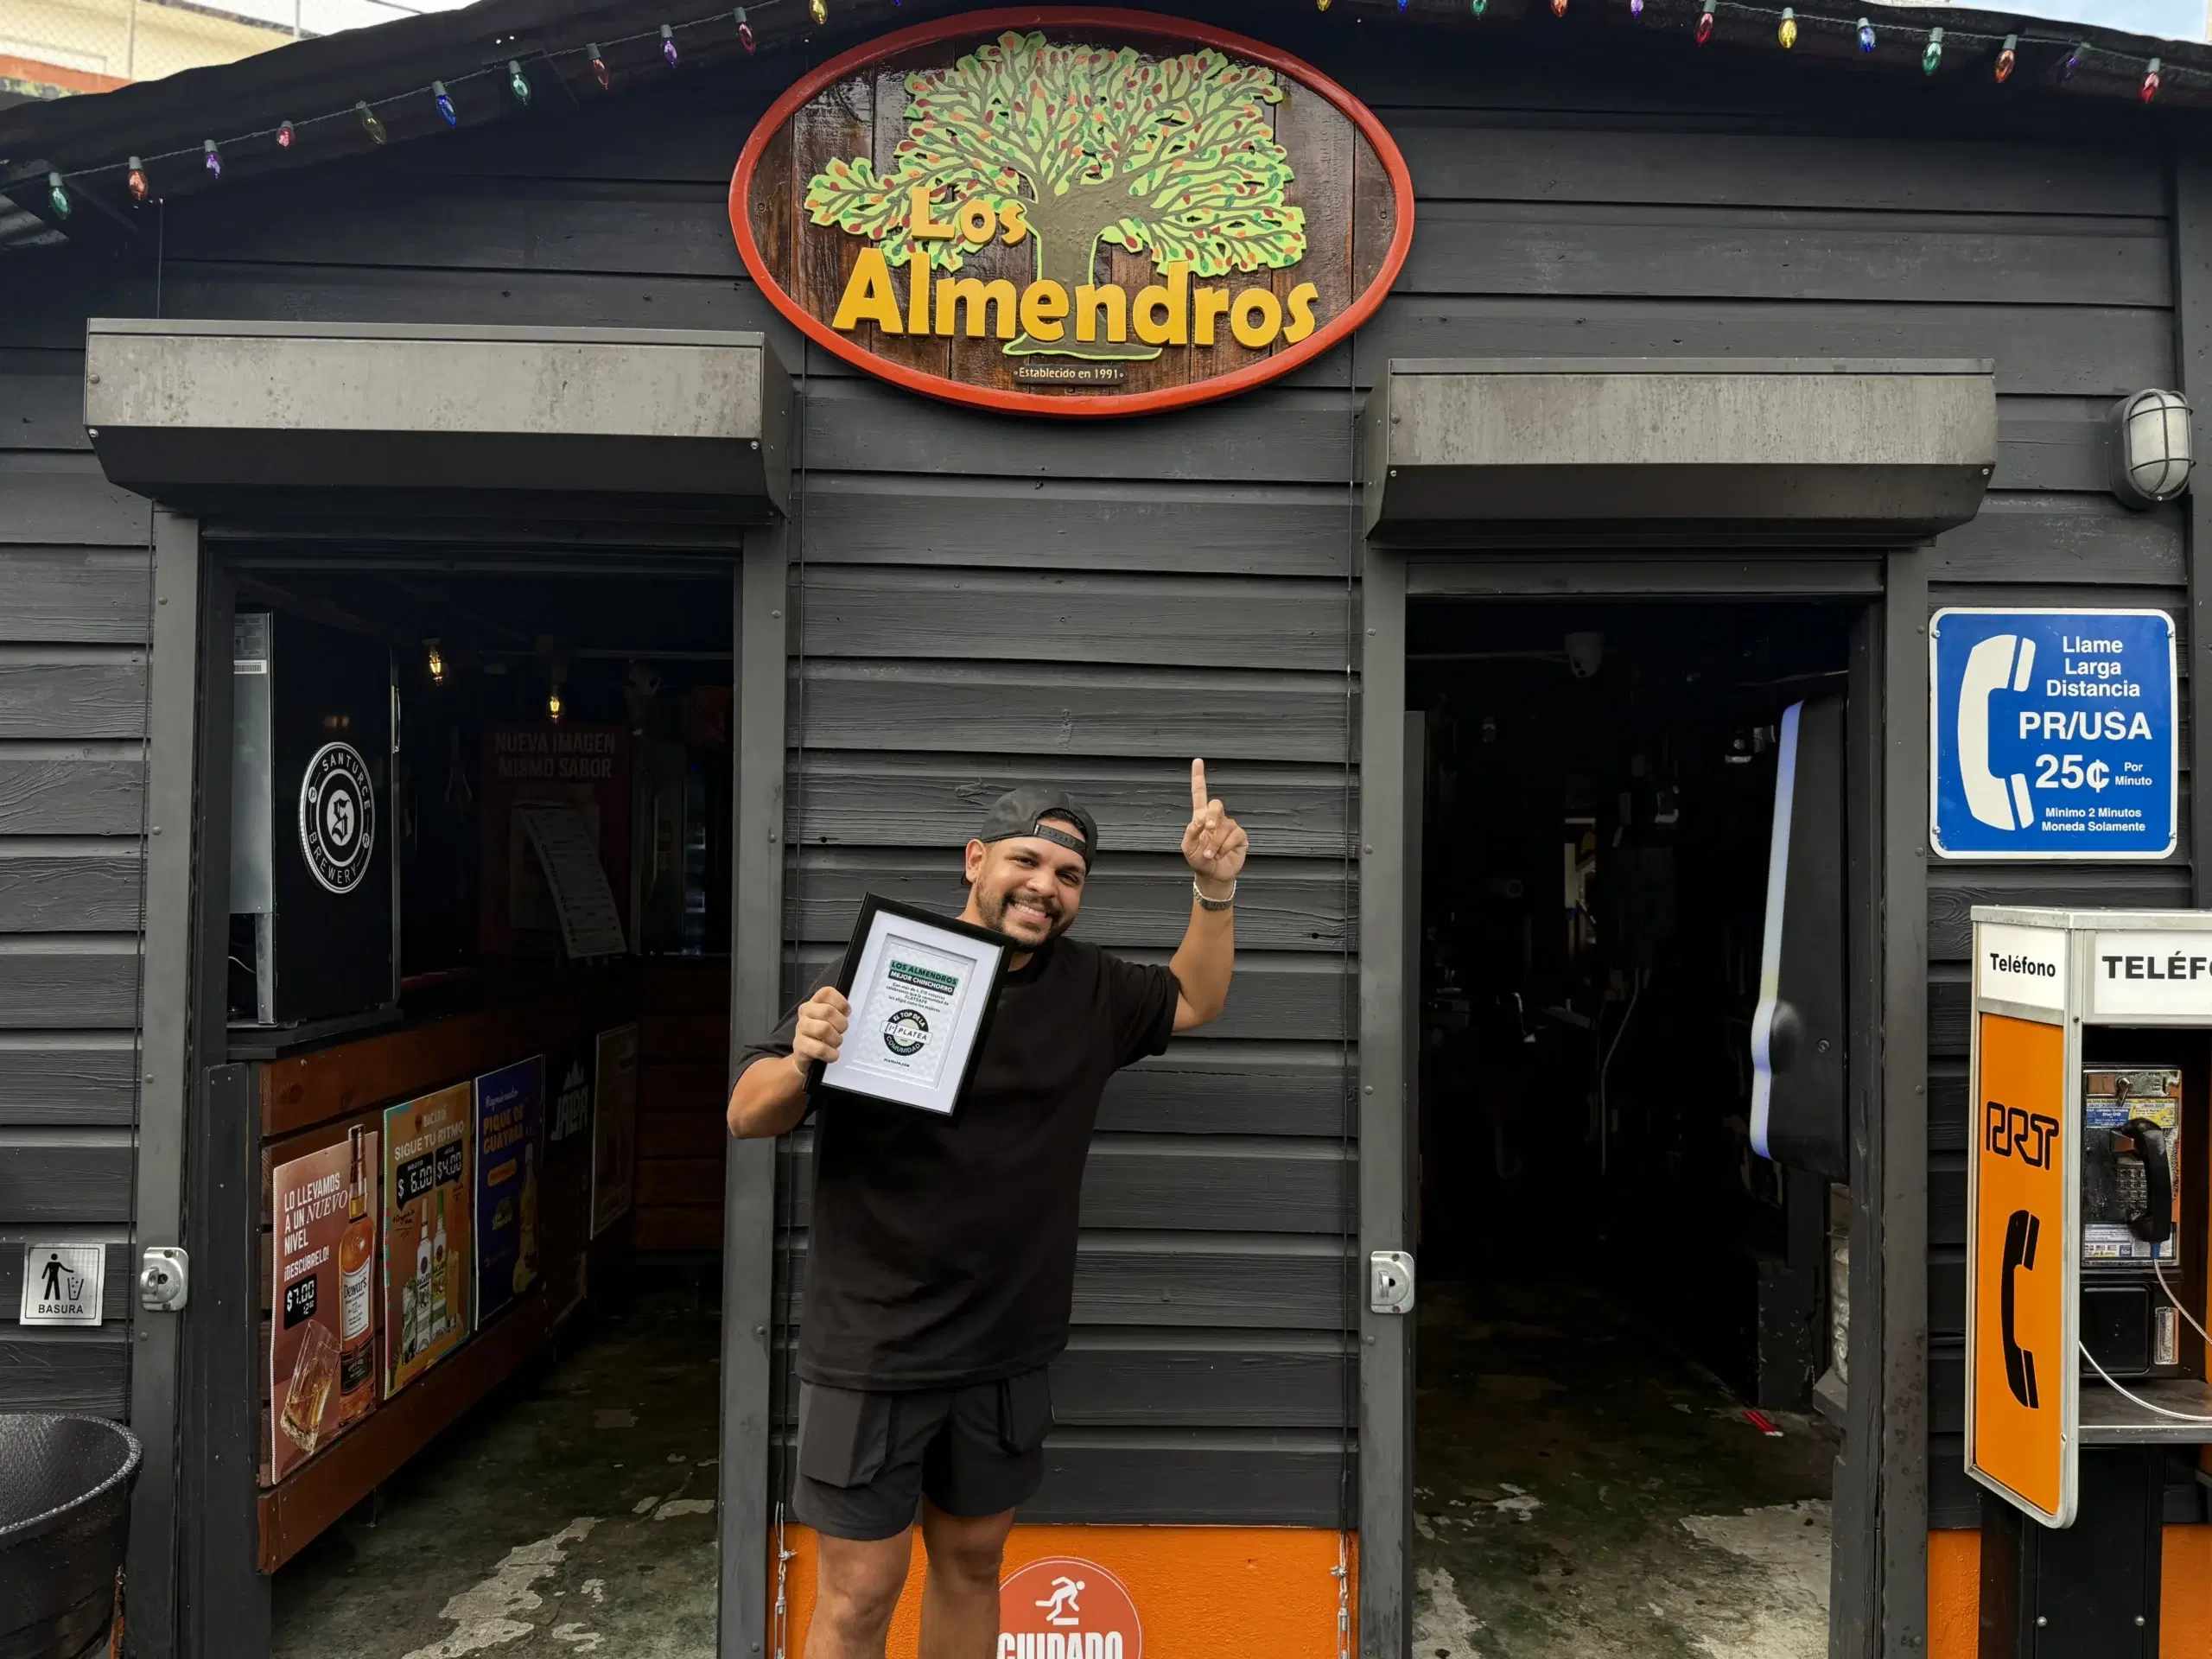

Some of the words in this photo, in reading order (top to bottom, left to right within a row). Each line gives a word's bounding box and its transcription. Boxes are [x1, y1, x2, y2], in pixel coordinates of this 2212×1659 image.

[912, 186, 1027, 245] Los
[831, 247, 1319, 348] Almendros
[1019, 367, 1076, 378] Establecido
[1095, 369, 1117, 379] 1991
[2063, 636, 2123, 653] Llame
[2065, 658, 2121, 679] Larga
[2046, 679, 2140, 697] Distancia
[2019, 711, 2152, 741] PR/USA
[2035, 753, 2110, 793] 25¢
[2124, 762, 2144, 772] Por
[322, 753, 371, 810] SANTURCE
[2115, 776, 2152, 786] Minuto
[2088, 808, 2095, 817] 2
[2098, 807, 2142, 817] Minutos
[2042, 822, 2085, 832] Moneda
[2088, 822, 2145, 832] Solamente
[309, 832, 357, 885] BREWERY
[892, 961, 908, 971] LOS
[908, 967, 957, 985] ALMENDROS
[1990, 952, 2056, 977] Teléfono
[2102, 951, 2212, 980] TELÉF
[890, 970, 912, 982] MEJOR
[912, 977, 953, 993] CHINCHORRO
[898, 1027, 927, 1040] PLATEA
[918, 1019, 925, 1027] LA
[887, 1035, 920, 1053] COMUNIDAD
[394, 1136, 423, 1161] SIGUE
[423, 1132, 435, 1147] TU
[438, 1120, 465, 1141] RITMO
[436, 1151, 461, 1181] $4.00
[284, 1191, 295, 1212] LO
[297, 1172, 340, 1208] LLEVAMOS
[284, 1214, 291, 1235] A
[293, 1208, 305, 1228] UN
[306, 1190, 348, 1224] NUEVO
[284, 1228, 308, 1256] NIVEL
[38, 1304, 84, 1314] BASURA
[287, 1280, 315, 1313] $7.00
[997, 1630, 1123, 1659] CUIDADO
